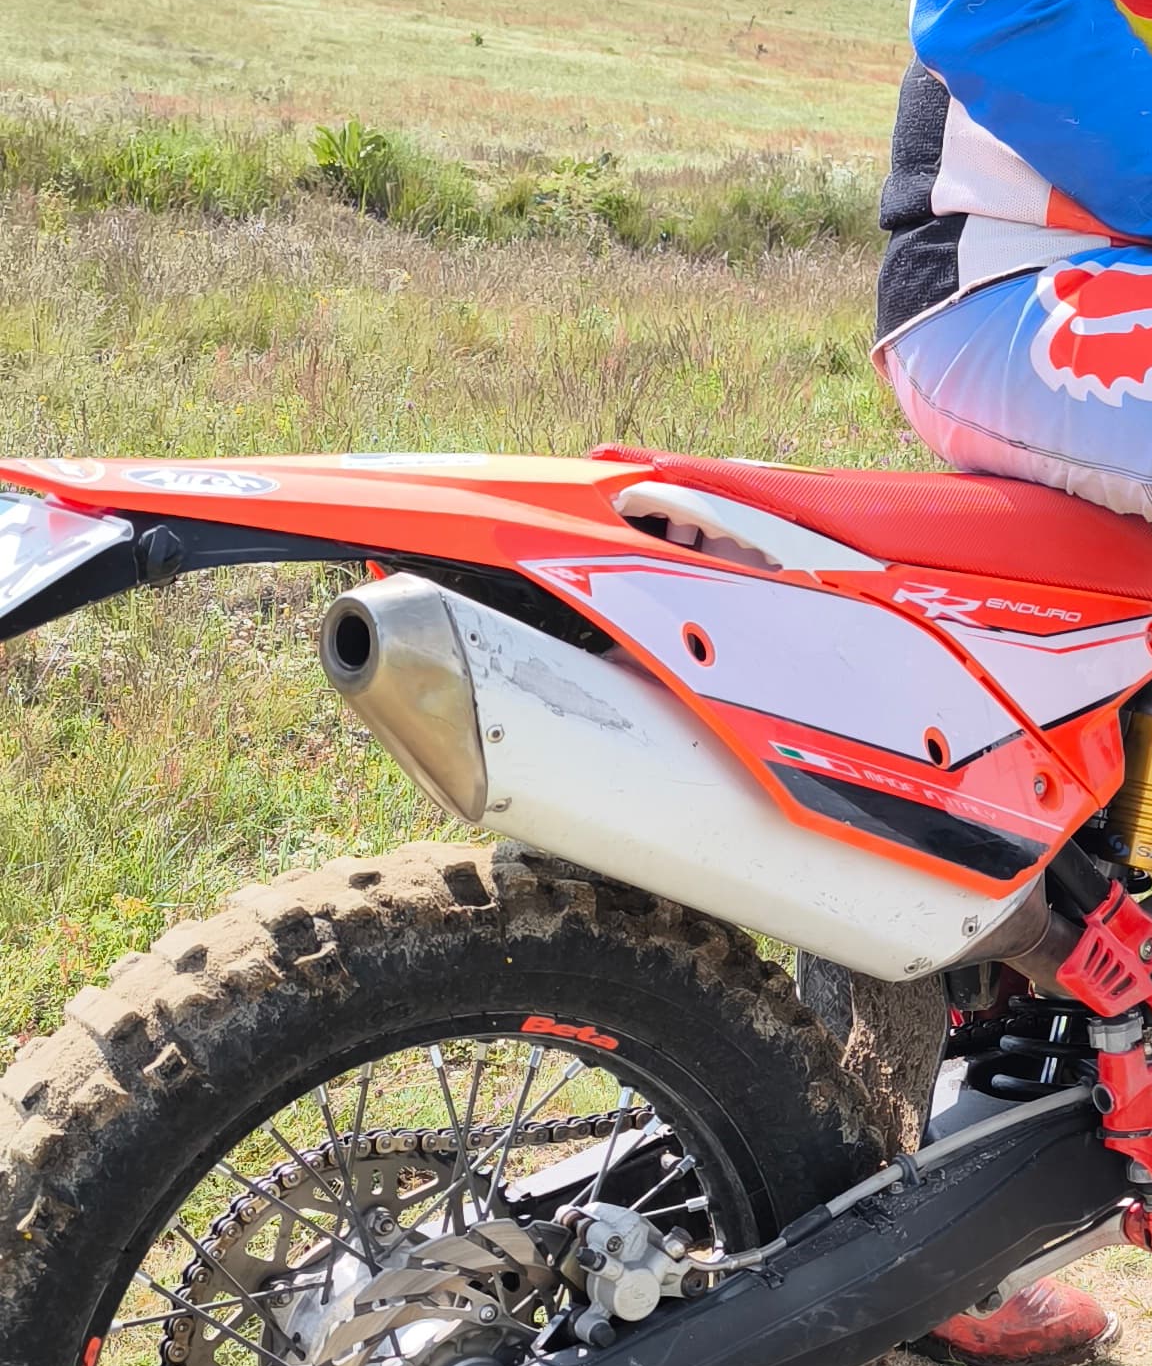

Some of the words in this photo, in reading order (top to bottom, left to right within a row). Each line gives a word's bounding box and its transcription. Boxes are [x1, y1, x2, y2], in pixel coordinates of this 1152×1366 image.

[984, 597, 1083, 623] ENDURO
[863, 770, 916, 793] MADE
[520, 1015, 619, 1050] Beta
